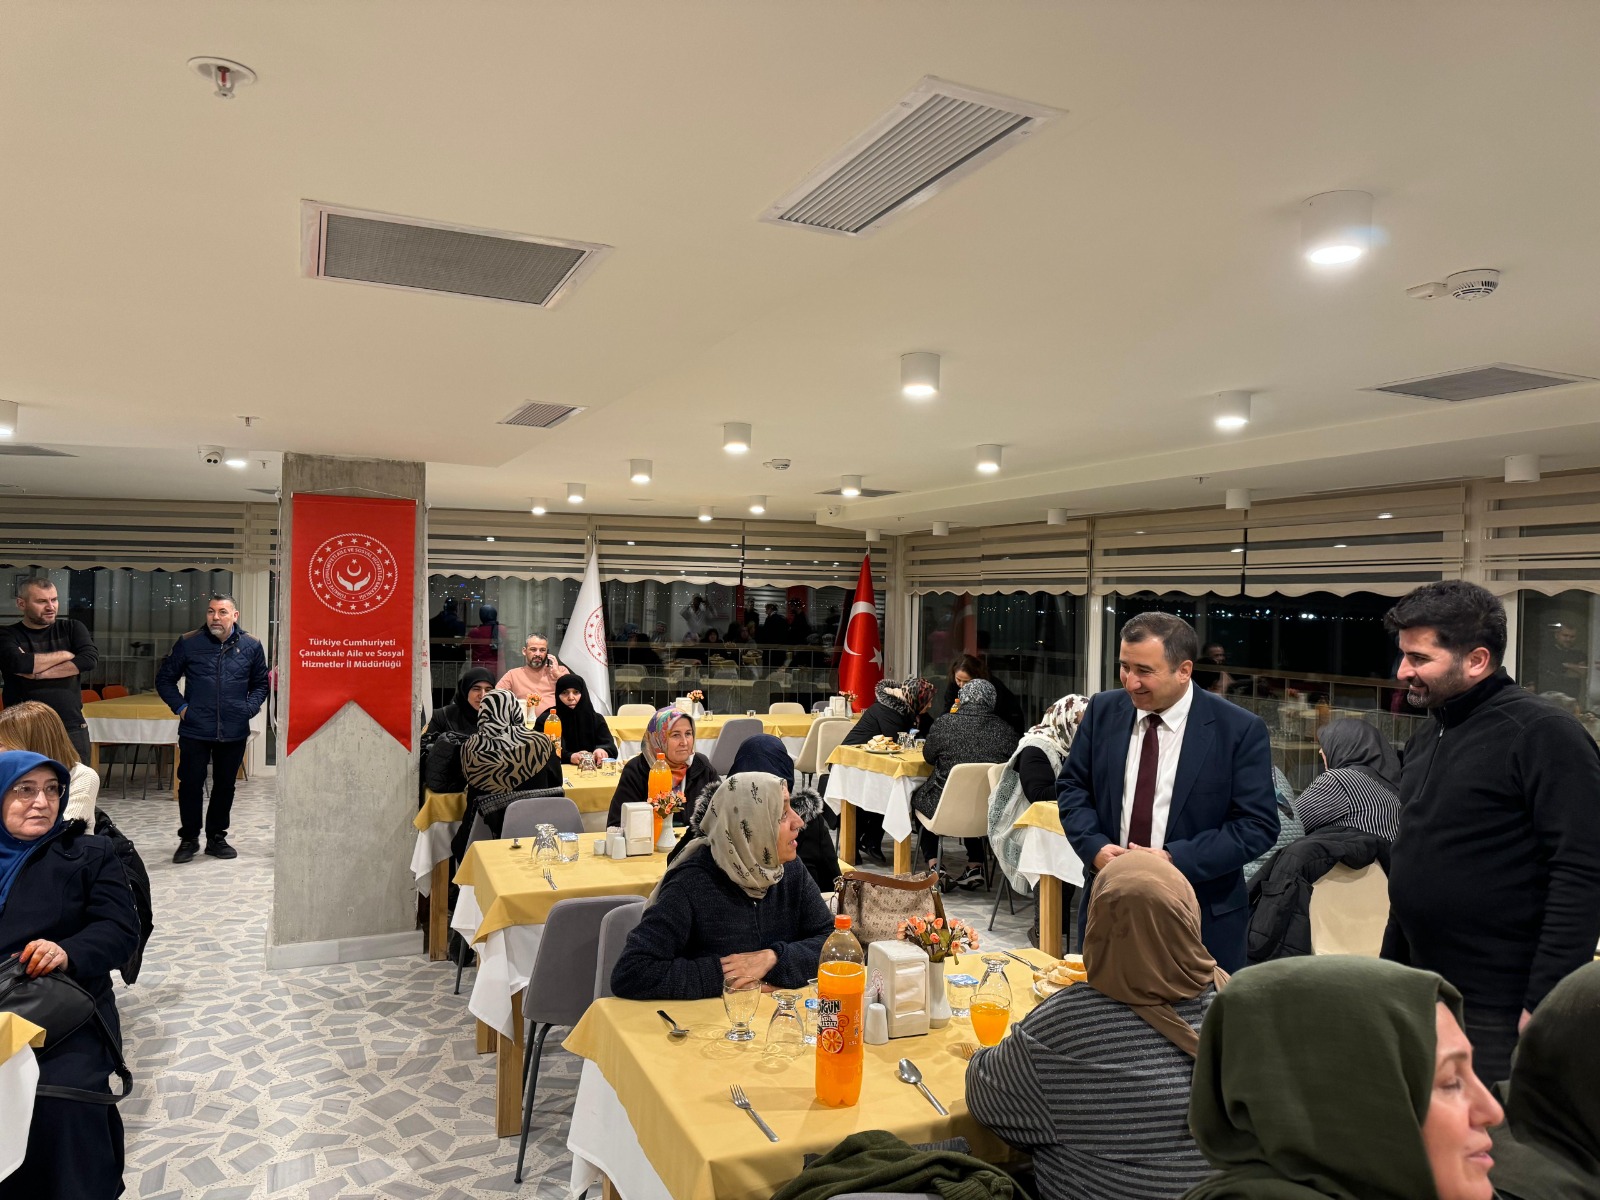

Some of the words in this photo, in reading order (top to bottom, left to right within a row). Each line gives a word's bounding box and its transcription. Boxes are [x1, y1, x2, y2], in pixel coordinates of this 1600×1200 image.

[308, 638, 341, 648] Türkiye
[342, 638, 396, 648] Cumhuriyeti
[299, 649, 345, 658] Çanakkale
[346, 649, 363, 657] Aile
[377, 649, 404, 658] Sosyal
[301, 660, 345, 668] Hizmetler
[346, 659, 352, 668] İl
[353, 660, 402, 669] Müdürlüğü
